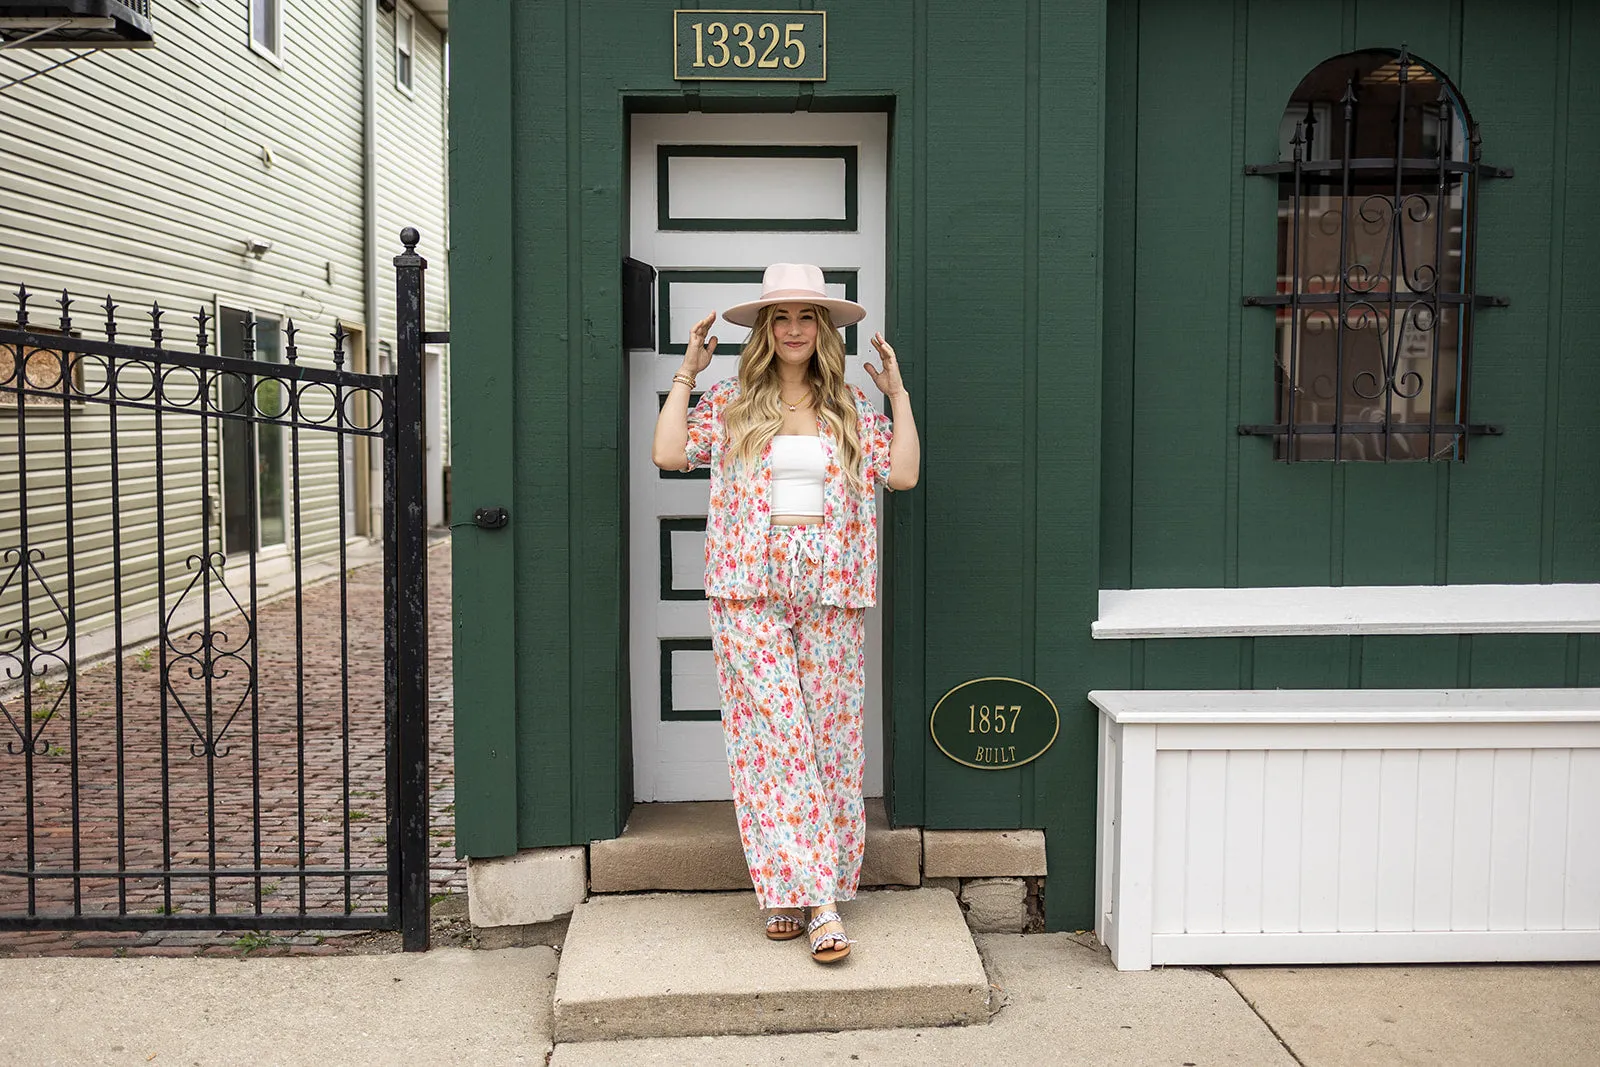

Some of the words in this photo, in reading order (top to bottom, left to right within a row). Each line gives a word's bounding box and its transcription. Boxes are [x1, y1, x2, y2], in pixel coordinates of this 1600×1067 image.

[692, 22, 806, 69] 13325
[968, 704, 1022, 734] 1857
[975, 746, 1016, 763] BUILT
